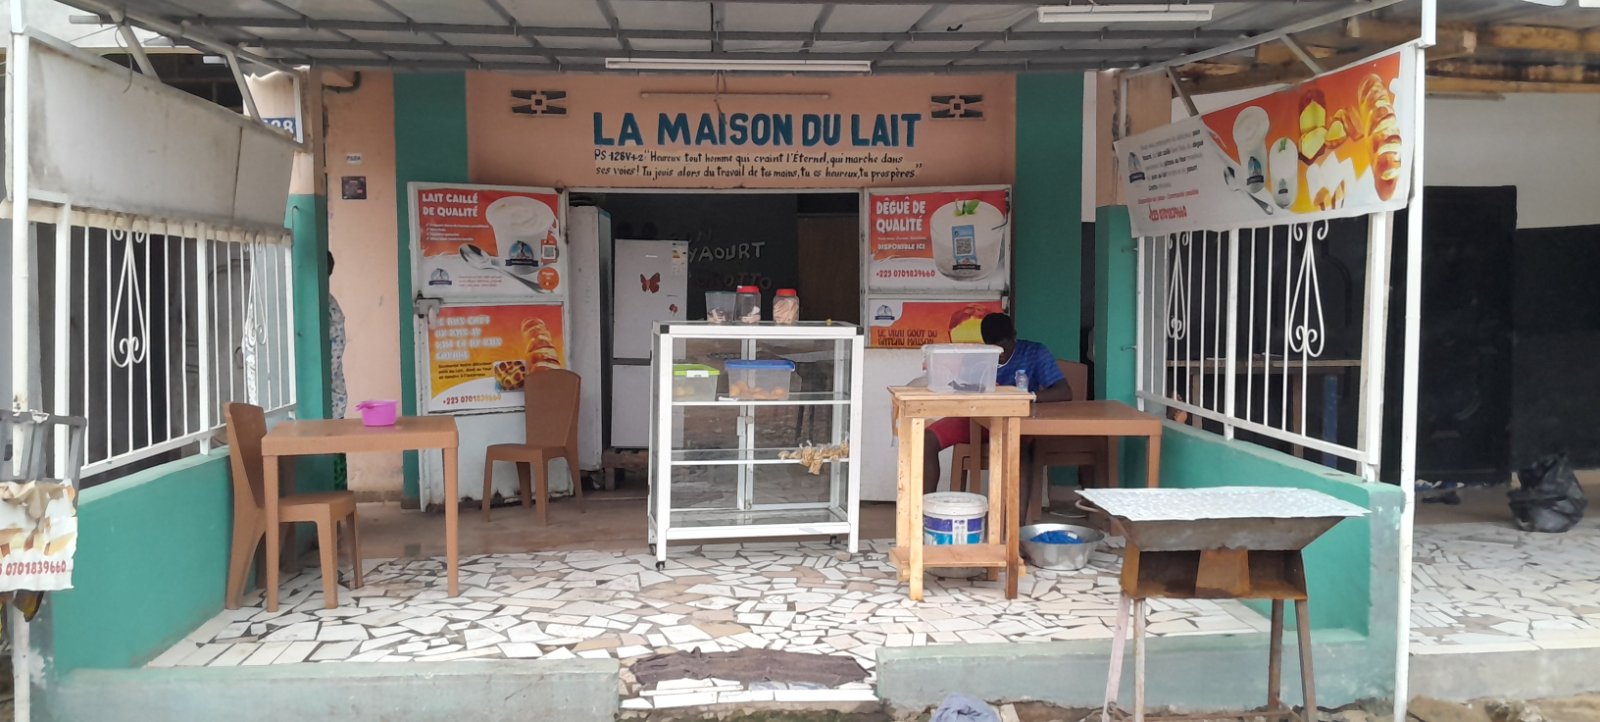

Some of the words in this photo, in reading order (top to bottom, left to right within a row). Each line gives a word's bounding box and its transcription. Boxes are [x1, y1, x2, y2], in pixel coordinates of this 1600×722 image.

[593, 112, 644, 146] LA
[658, 112, 794, 147] MAISON
[802, 113, 841, 147] DU
[851, 113, 922, 147] LAIT
[593, 149, 607, 161] PS
[684, 153, 702, 162] tout
[705, 153, 733, 163] homme
[735, 154, 750, 168] qui
[754, 153, 784, 163] craint
[845, 153, 878, 163] marche
[881, 153, 903, 164] dans
[595, 166, 610, 176] ses
[642, 166, 652, 177] Tu
[677, 166, 700, 177] alors
[703, 165, 715, 177] du
[717, 165, 745, 177] travail
[748, 165, 758, 177] de
[760, 166, 772, 178] tes
[813, 169, 822, 177] es
[422, 193, 444, 204] LAIT
[446, 192, 479, 204] CAILLÉ
[422, 206, 435, 216] DE
[437, 205, 479, 217] QUALITÉ
[912, 201, 926, 215] DE
[876, 215, 923, 233] QUALITÉ
[689, 241, 766, 263] YAOURT
[877, 242, 915, 251] DISPONIBLE
[916, 242, 926, 250] ICI
[5, 560, 67, 577] 0701839660
